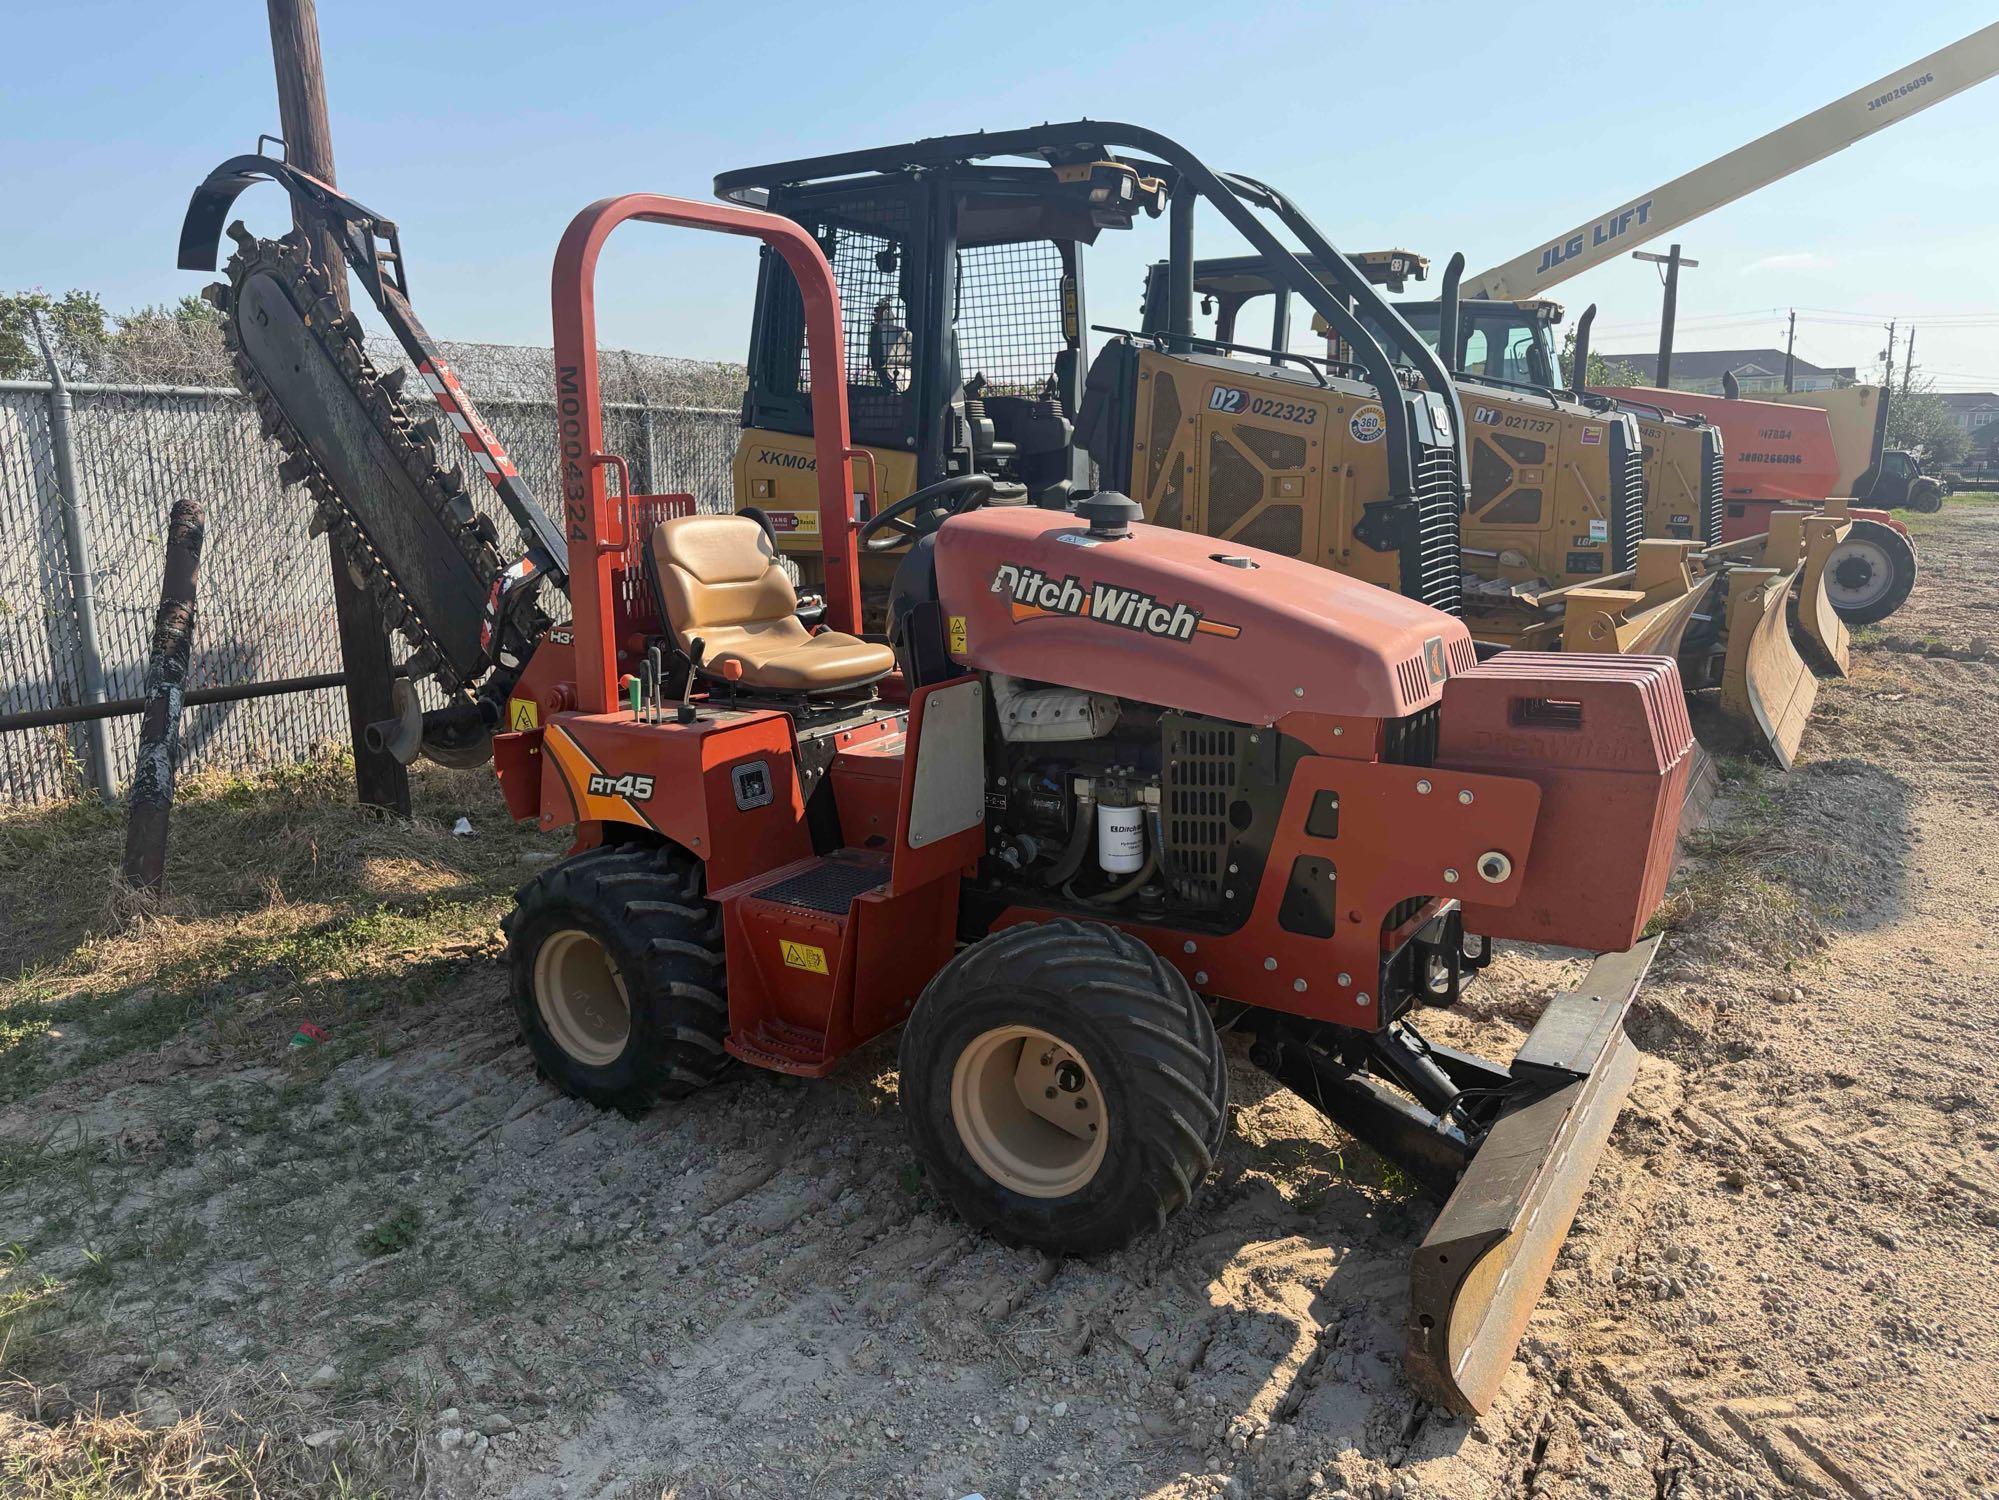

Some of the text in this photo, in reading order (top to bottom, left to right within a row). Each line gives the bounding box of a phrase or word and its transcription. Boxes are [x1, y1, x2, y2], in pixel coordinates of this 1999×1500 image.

[1536, 200, 1653, 275] JLG LIFT
[1208, 386, 1317, 425] D2 022323
[1360, 417, 1378, 428] 360
[1473, 405, 1555, 433] D1 021737
[757, 449, 818, 473] XKM04
[991, 564, 1197, 640] Ditch Witch
[550, 630, 575, 645] H3
[591, 775, 653, 799] RT45
